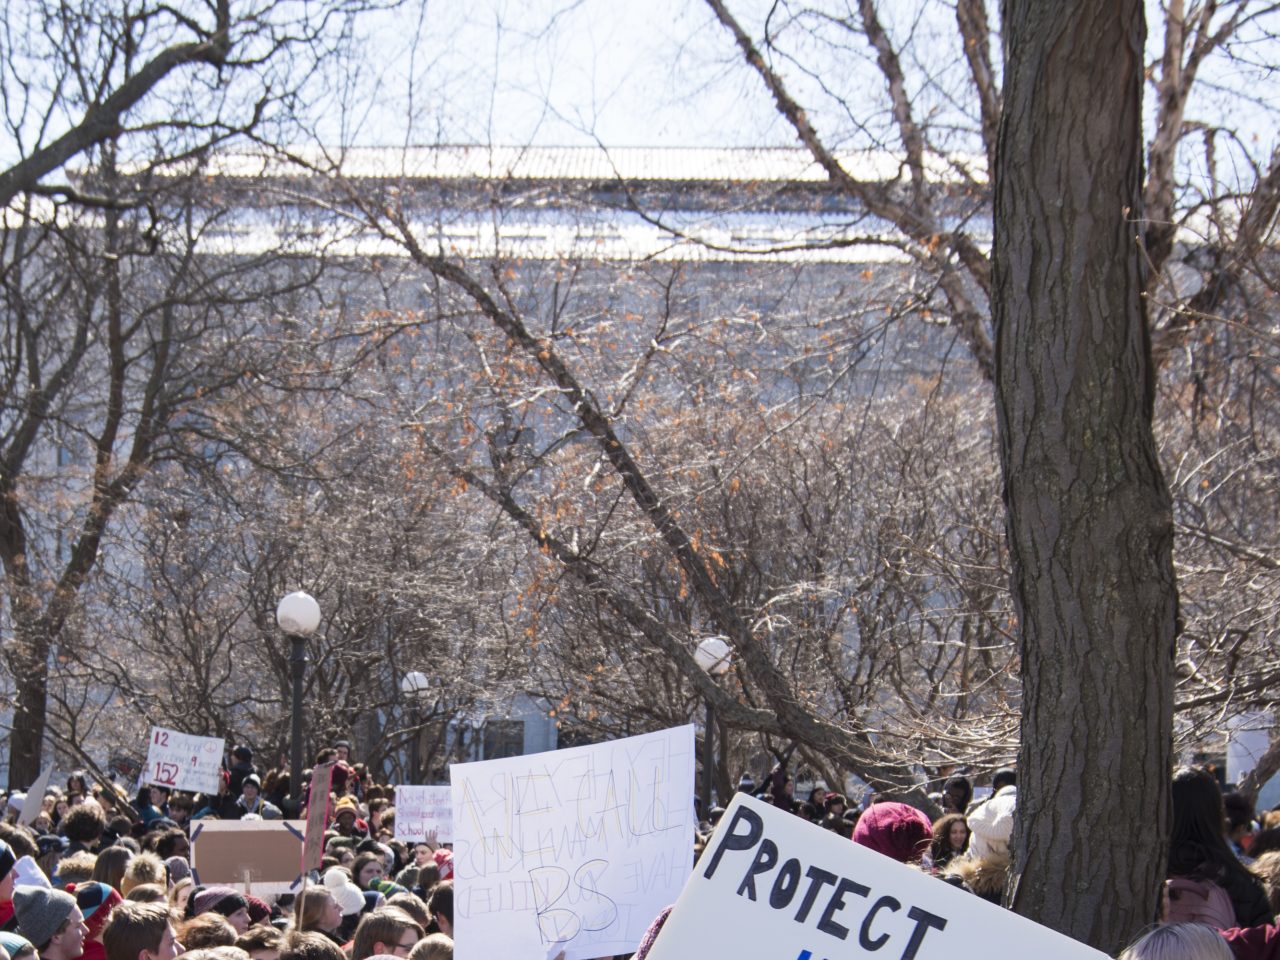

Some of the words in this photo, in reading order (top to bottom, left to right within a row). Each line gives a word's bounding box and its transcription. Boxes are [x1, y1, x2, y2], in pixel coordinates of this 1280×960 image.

[154, 731, 169, 747] 12
[153, 761, 179, 786] 152
[528, 858, 618, 945] BS
